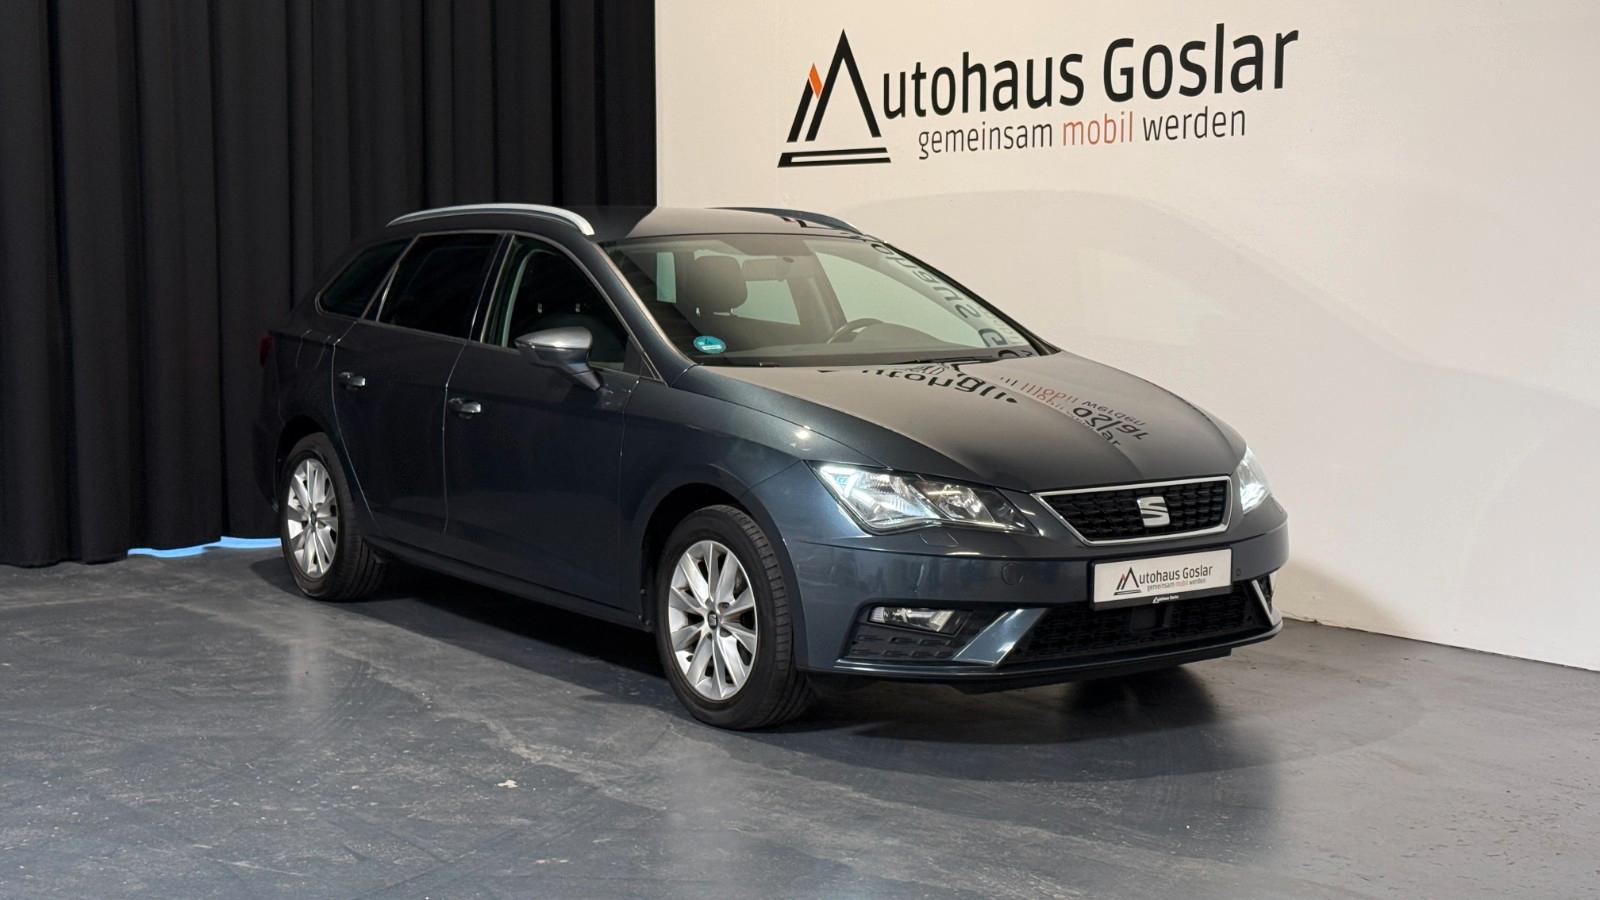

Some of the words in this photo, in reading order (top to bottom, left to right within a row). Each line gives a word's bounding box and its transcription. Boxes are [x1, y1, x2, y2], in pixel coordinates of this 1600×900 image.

[1102, 22, 1300, 103] Goslar
[917, 123, 1053, 161] gemeinsam
[1063, 112, 1134, 146] mobil
[1142, 106, 1246, 142] werden
[1182, 564, 1213, 580] Goslar
